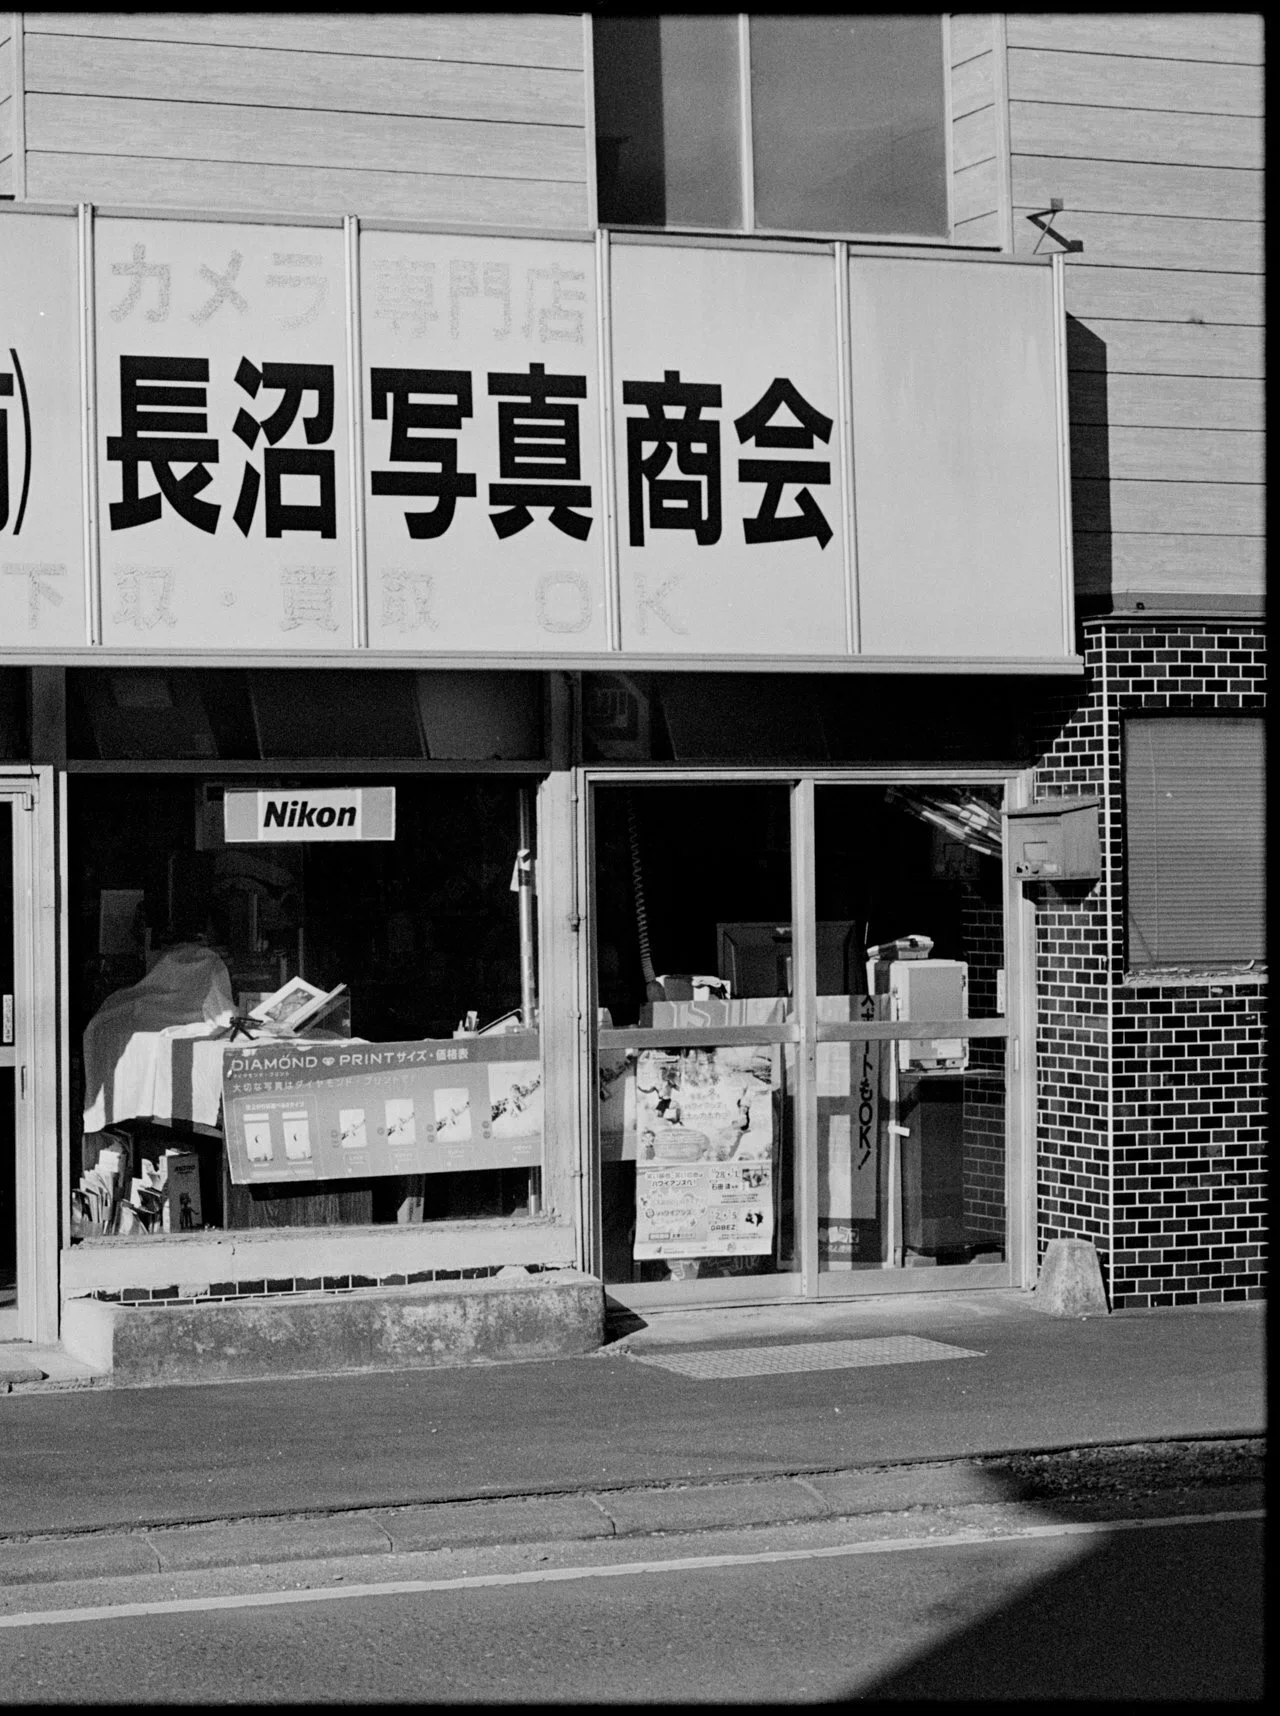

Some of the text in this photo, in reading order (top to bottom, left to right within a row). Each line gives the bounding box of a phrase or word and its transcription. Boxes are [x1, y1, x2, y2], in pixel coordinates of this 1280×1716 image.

[109, 243, 587, 345] カメラ専門店
[263, 801, 357, 828] Nikon
[340, 1052, 395, 1066] PRINT
